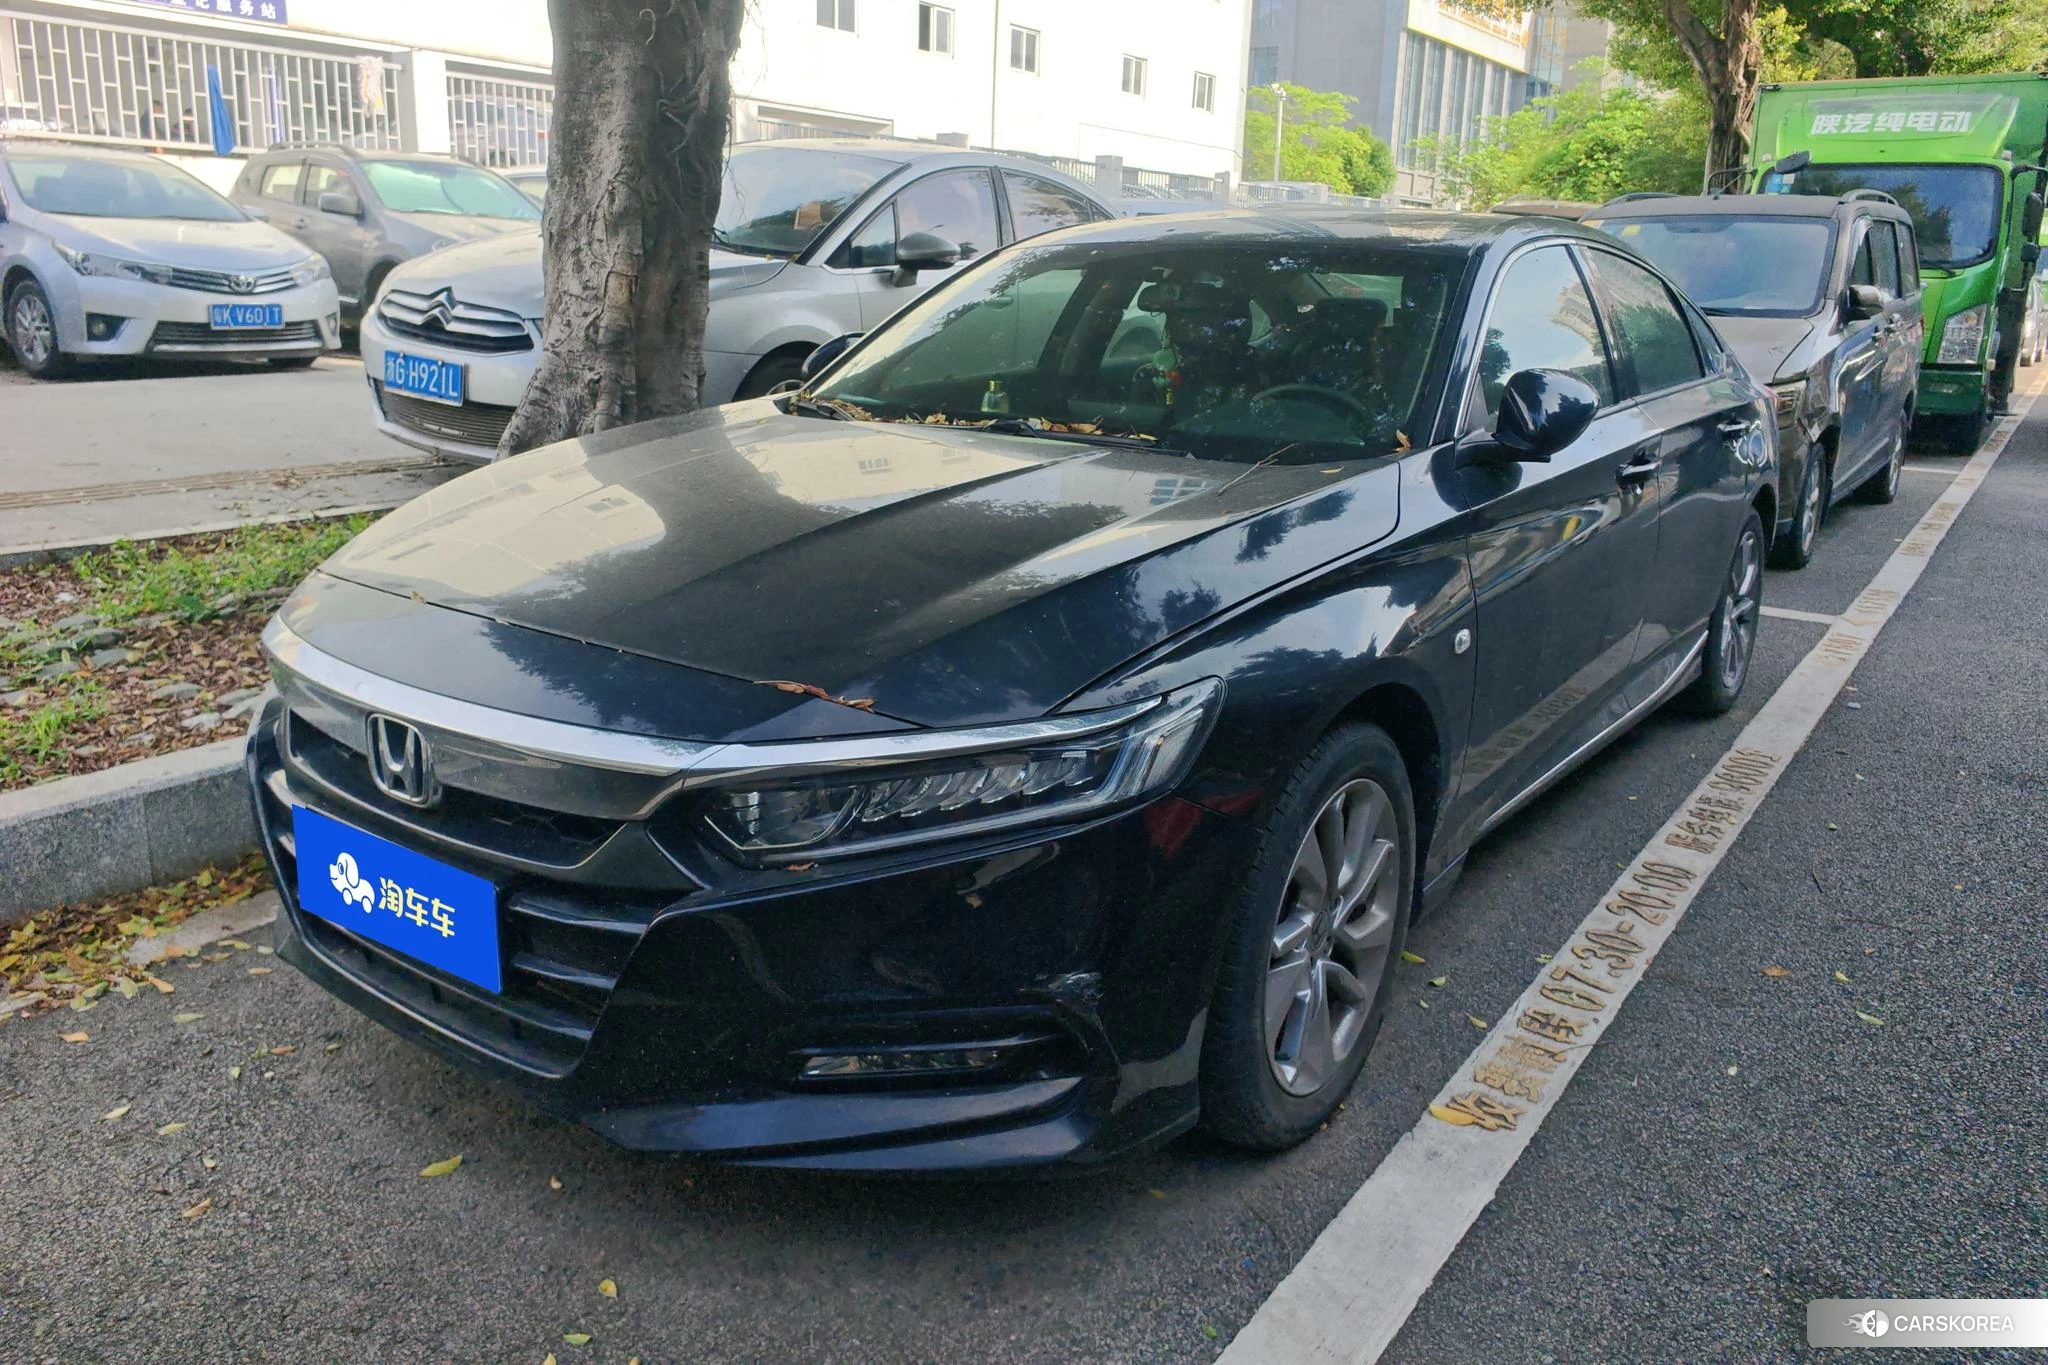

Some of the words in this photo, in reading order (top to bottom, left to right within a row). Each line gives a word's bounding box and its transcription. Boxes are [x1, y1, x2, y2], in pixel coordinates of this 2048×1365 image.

[1811, 111, 1972, 135] 陕汽纯电动
